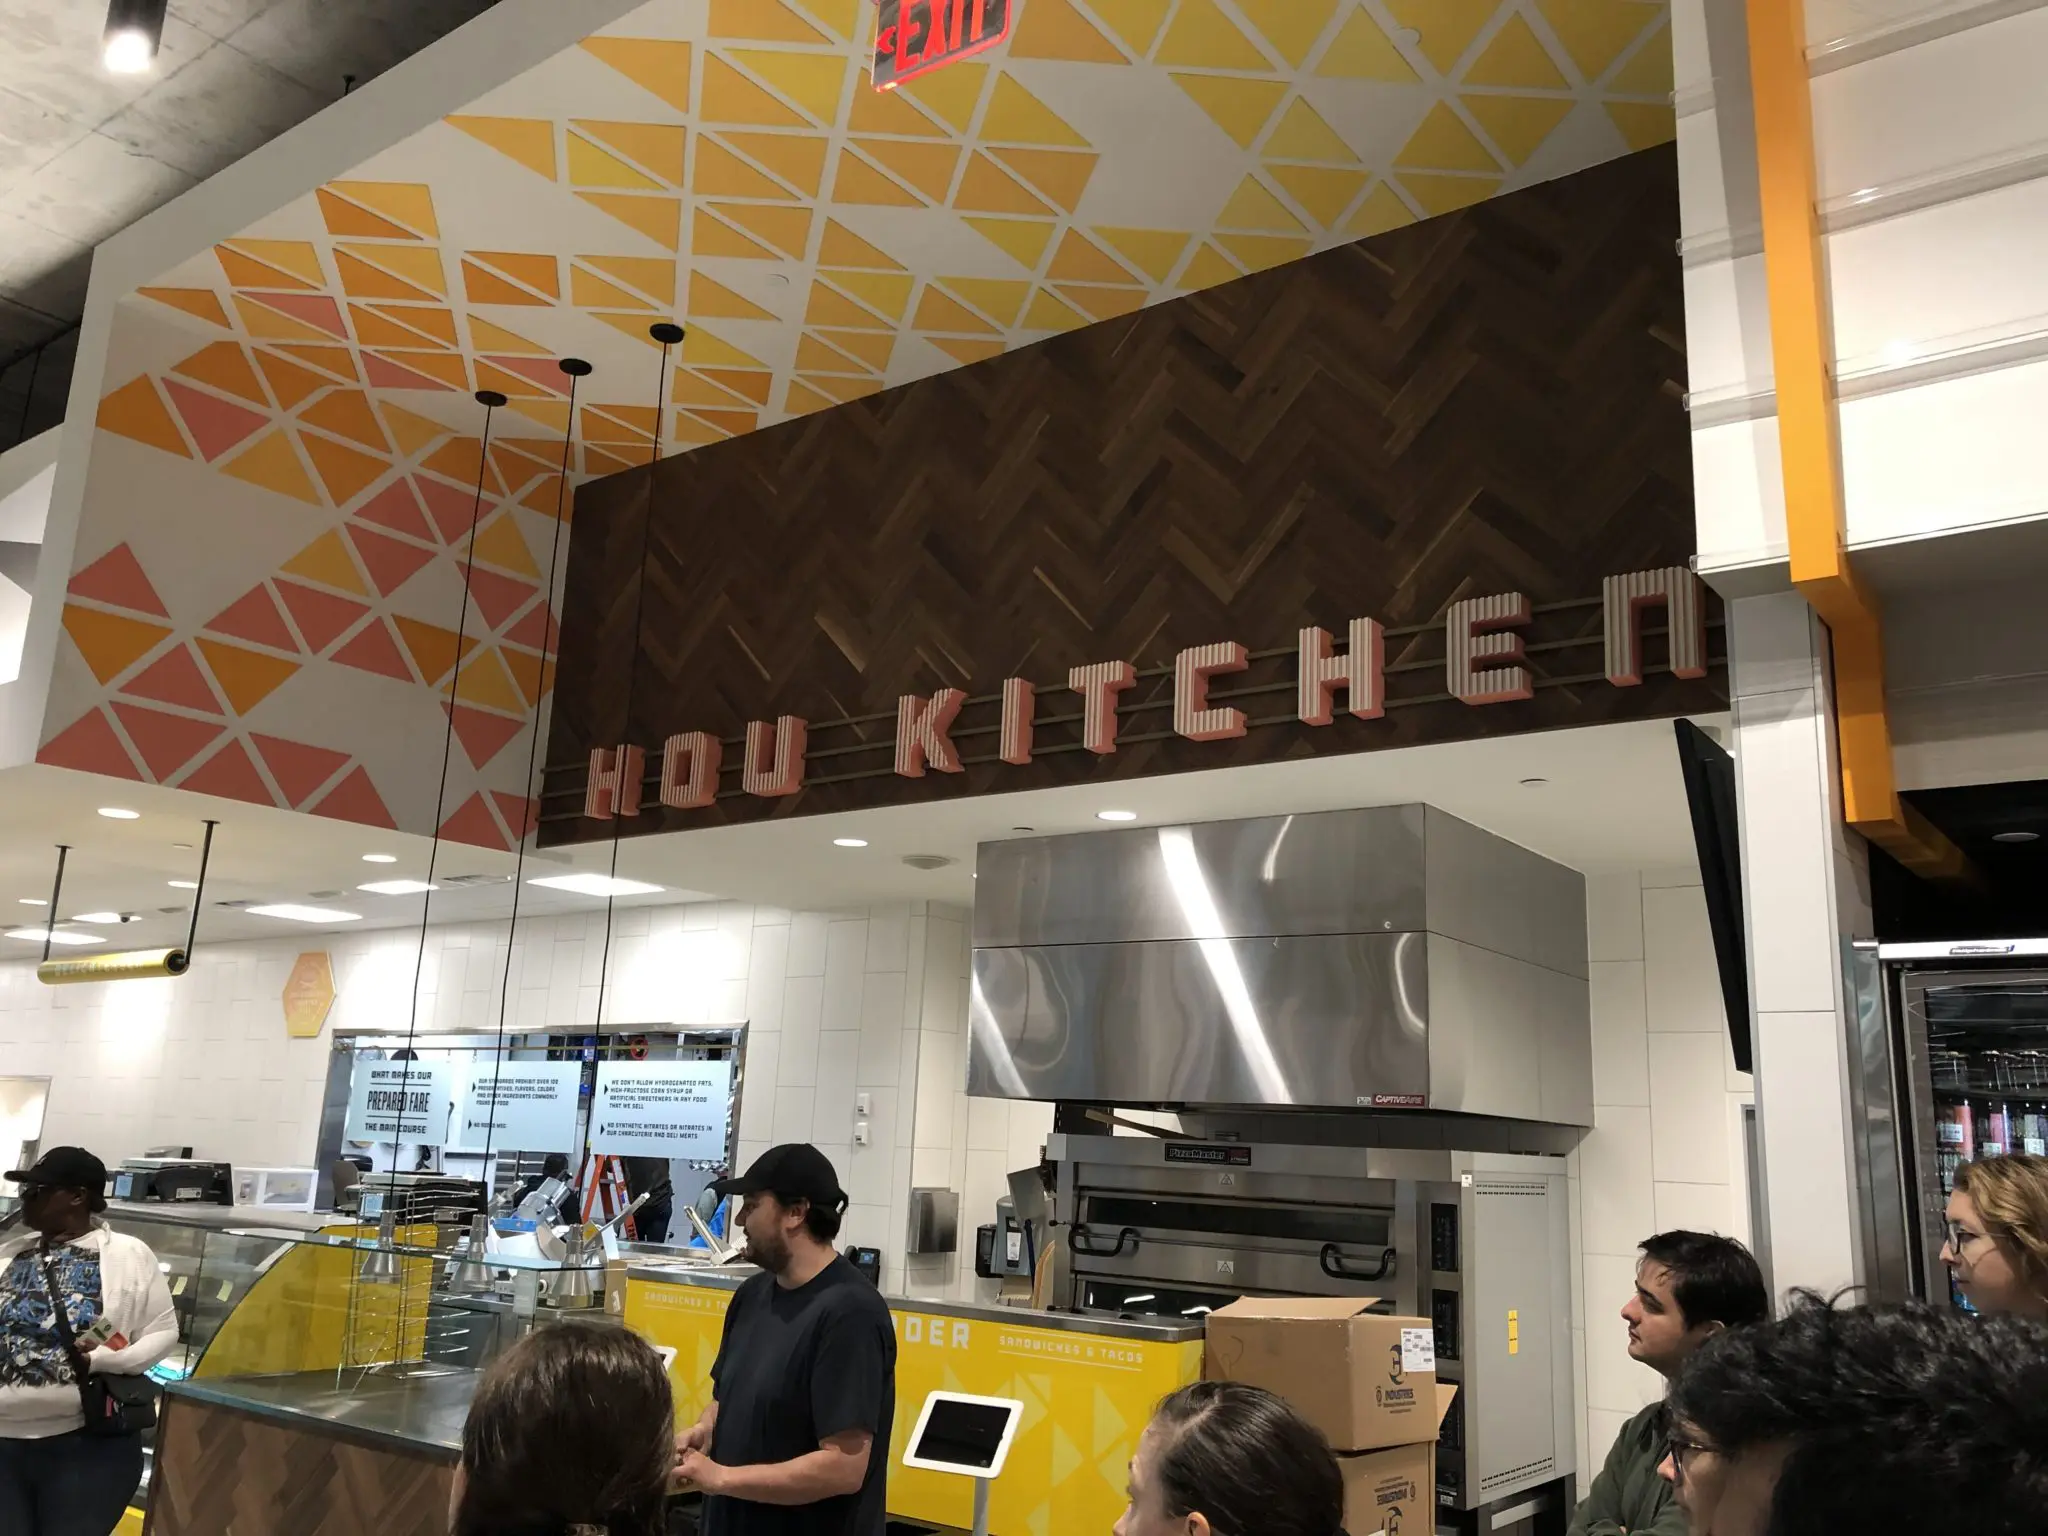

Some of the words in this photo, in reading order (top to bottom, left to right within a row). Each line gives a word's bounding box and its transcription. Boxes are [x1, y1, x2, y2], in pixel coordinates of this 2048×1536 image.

[584, 714, 808, 820] HOU
[895, 566, 1706, 778] KITCHEN
[371, 1070, 390, 1079] WHAT
[417, 1071, 432, 1080] OUR
[366, 1090, 408, 1112] PREPARED
[408, 1092, 431, 1113] FARE
[365, 1122, 378, 1132] THE
[379, 1123, 396, 1132] MAIN
[397, 1124, 427, 1134] COURSE
[679, 1132, 698, 1140] MEATS
[890, 1314, 970, 1350] DER
[999, 1334, 1080, 1356] SANDWICHES
[1100, 1347, 1144, 1364] TACOS
